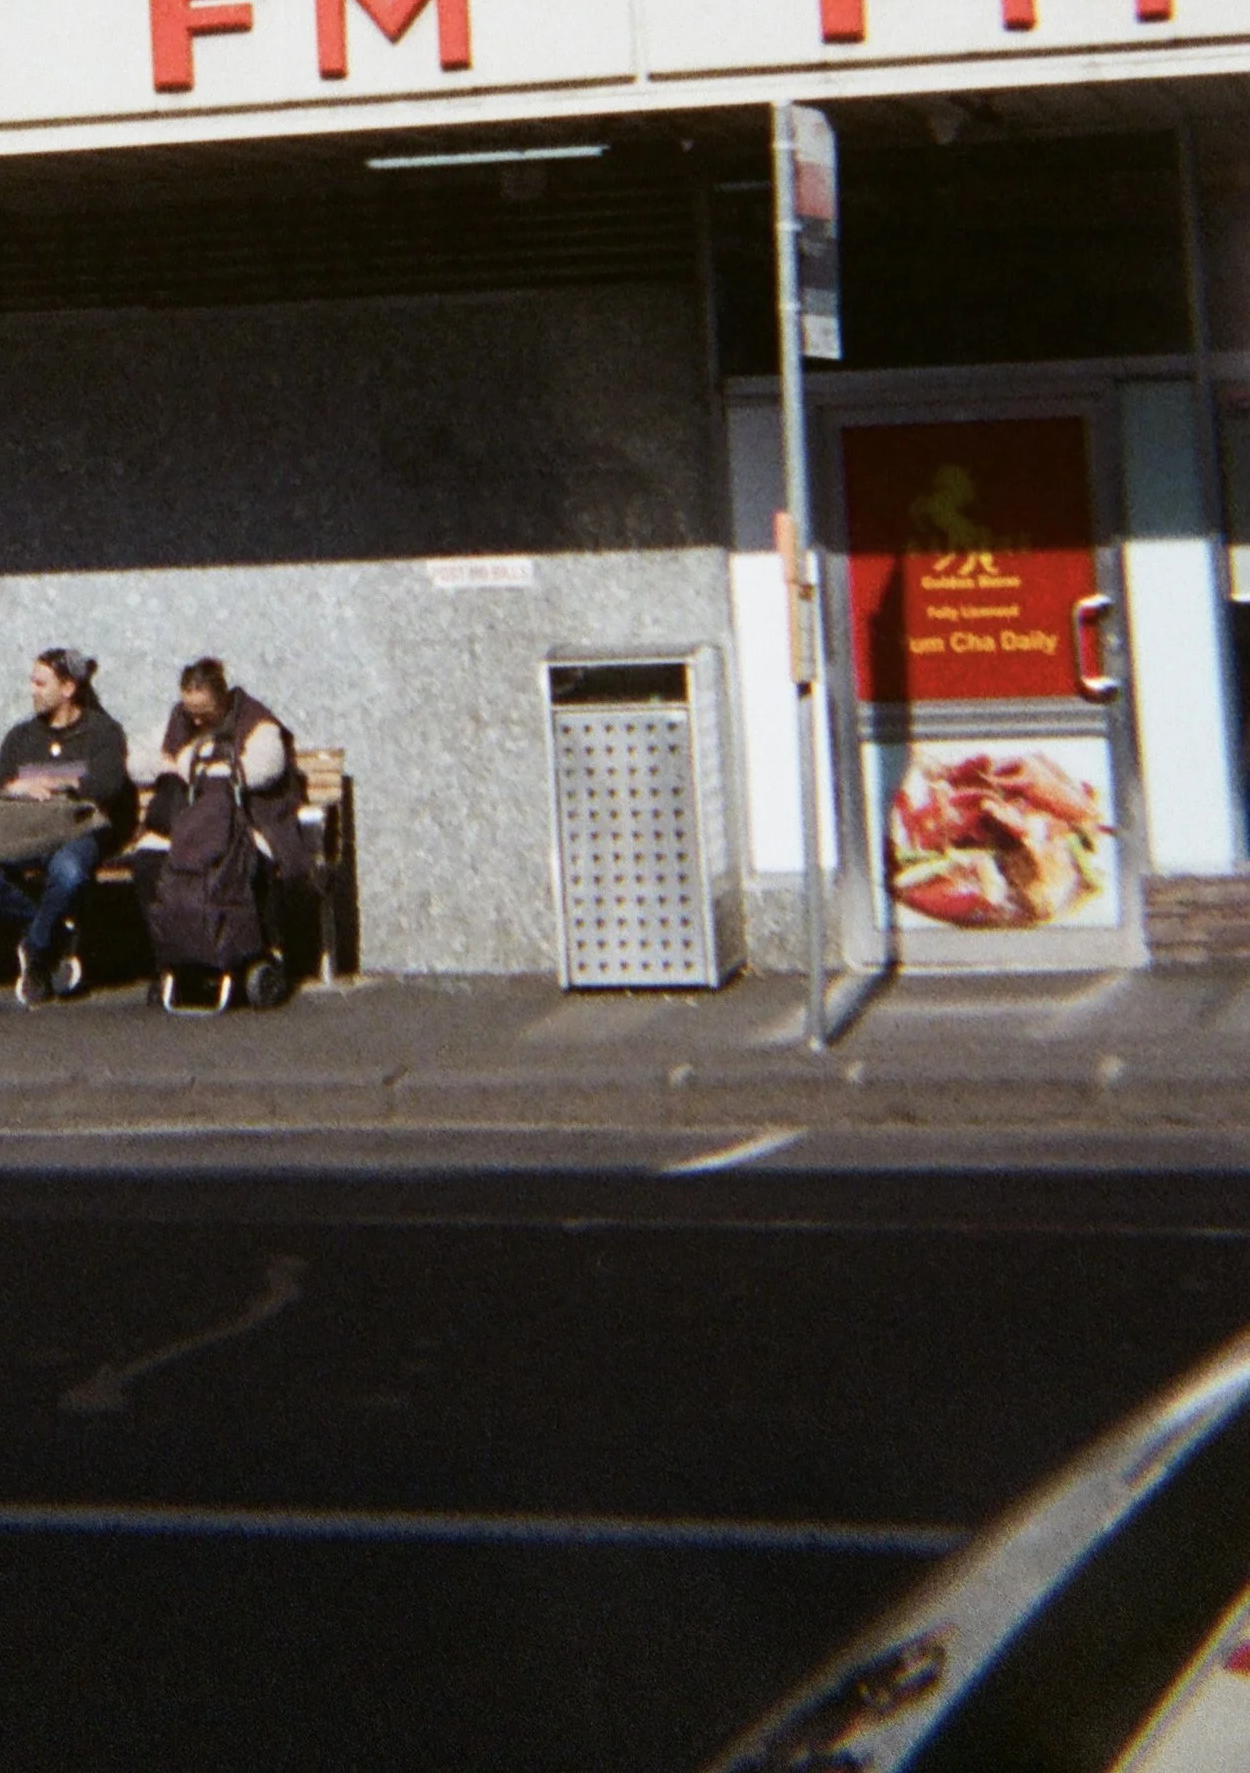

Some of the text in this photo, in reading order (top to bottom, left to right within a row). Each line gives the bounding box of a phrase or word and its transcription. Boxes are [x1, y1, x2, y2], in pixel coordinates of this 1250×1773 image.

[908, 629, 1059, 656] um Cha Daily
